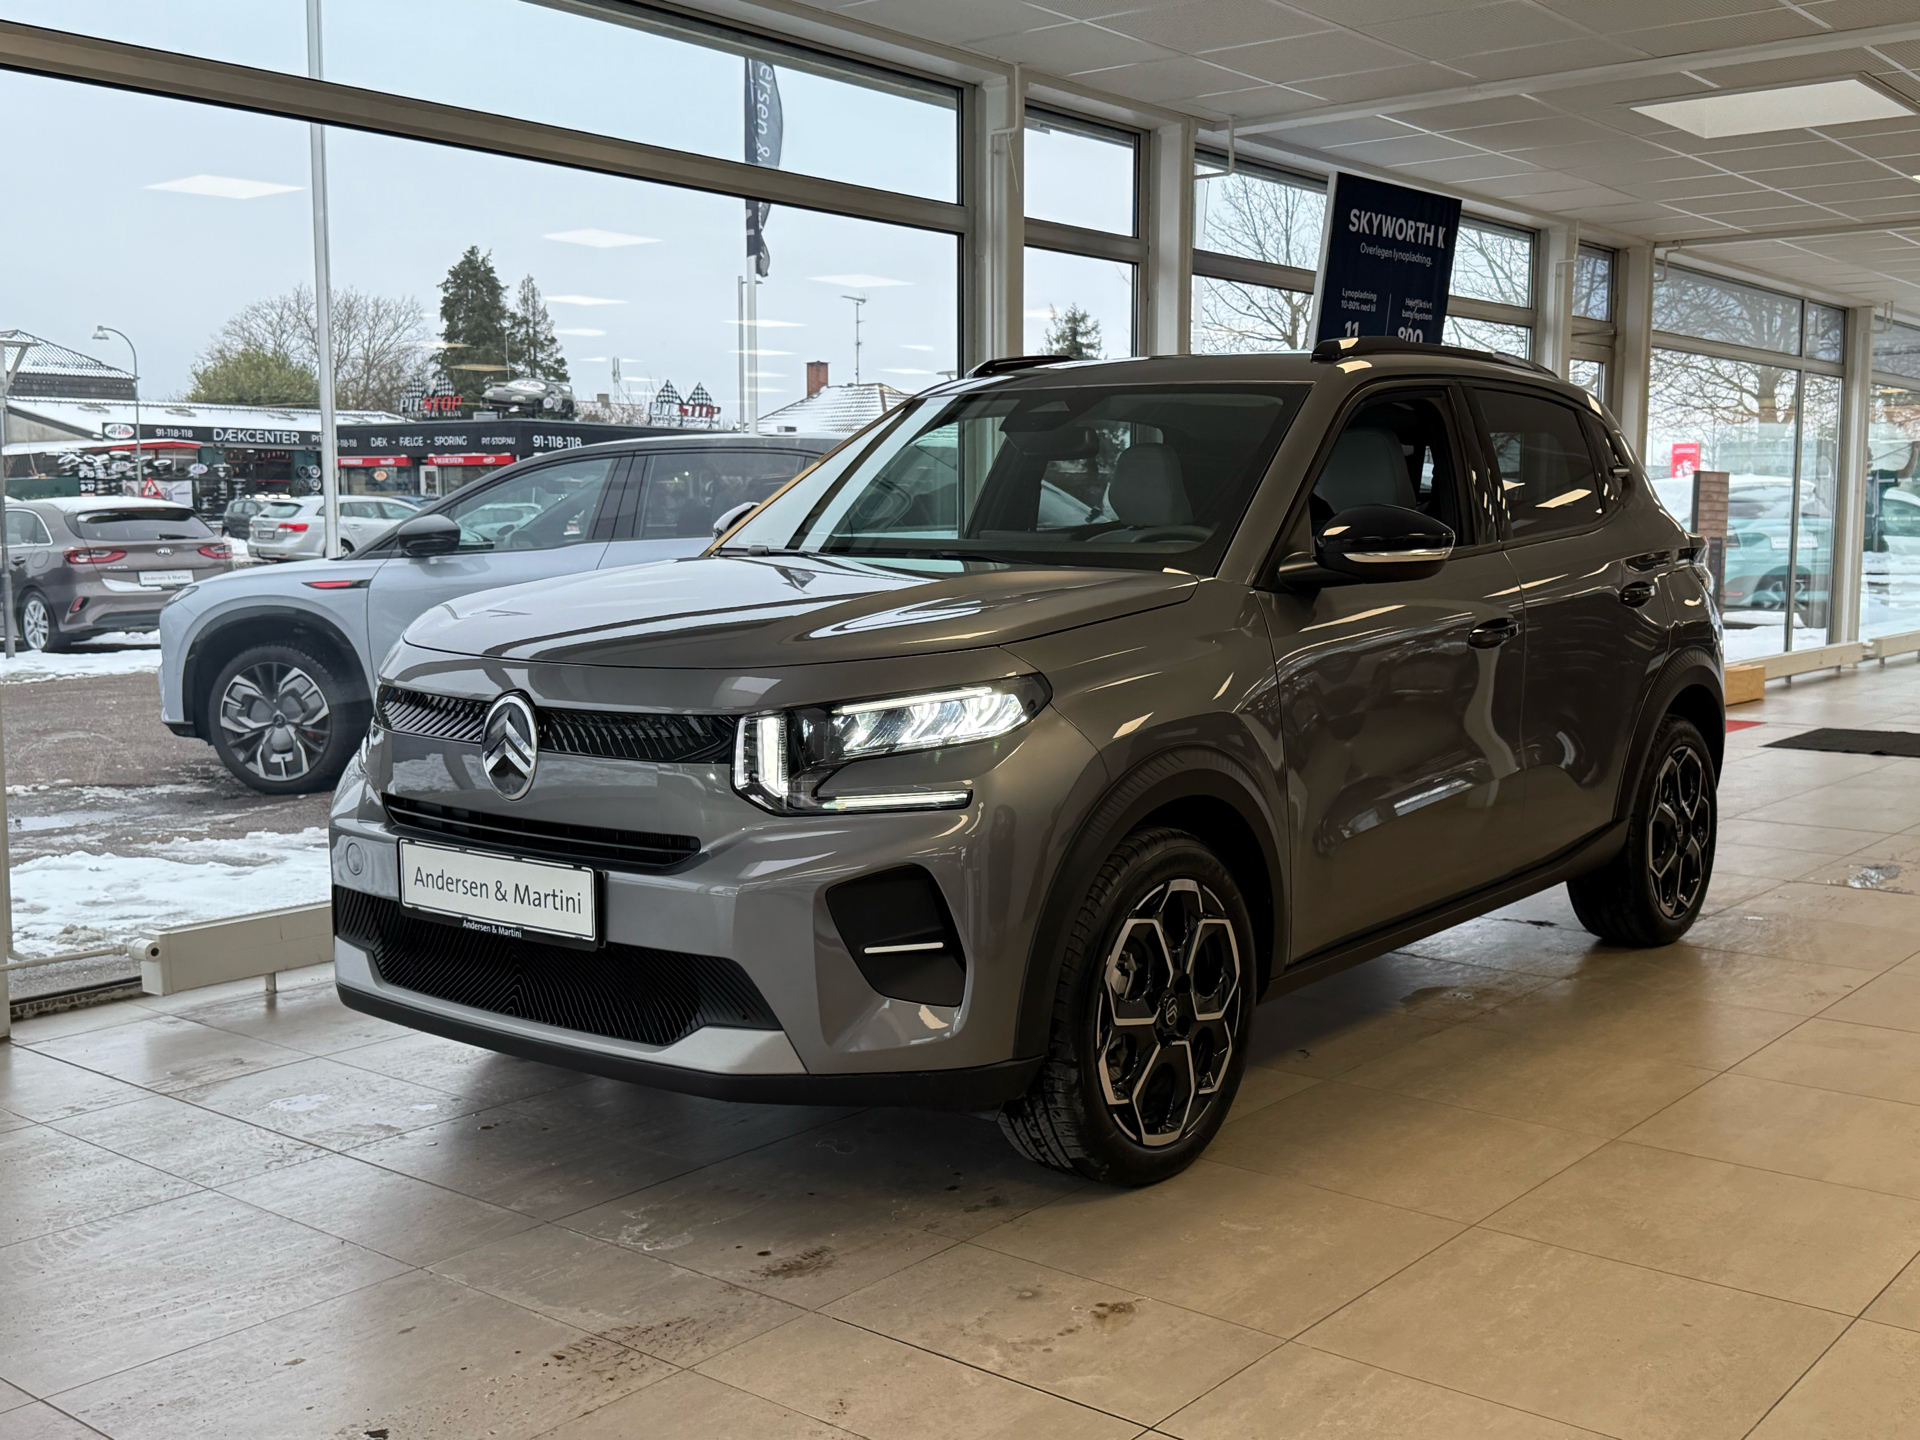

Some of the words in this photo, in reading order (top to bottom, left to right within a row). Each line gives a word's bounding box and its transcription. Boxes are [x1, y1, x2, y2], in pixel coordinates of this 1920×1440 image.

[1348, 208, 1435, 247] SKYWORTH
[1437, 226, 1446, 249] K
[1360, 242, 1393, 260] Overlegen
[1393, 248, 1433, 268] lynopladning.
[1341, 287, 1377, 302] Lynopladning
[1341, 300, 1360, 310] 10-80%
[399, 398, 420, 412] PIT
[424, 396, 462, 411] STOP
[155, 428, 194, 438] 91-118-118
[213, 428, 300, 444] DÆKCENTER
[370, 437, 388, 447] DÆK
[399, 436, 424, 447] FÆLGE
[434, 435, 467, 446] SPORING
[532, 434, 583, 448] 91-118-118
[414, 866, 489, 899] Andersen
[494, 880, 508, 903] &
[513, 883, 582, 914] Martini
[462, 919, 491, 933] Andersen
[491, 925, 497, 934] &
[498, 926, 522, 939] Martini
